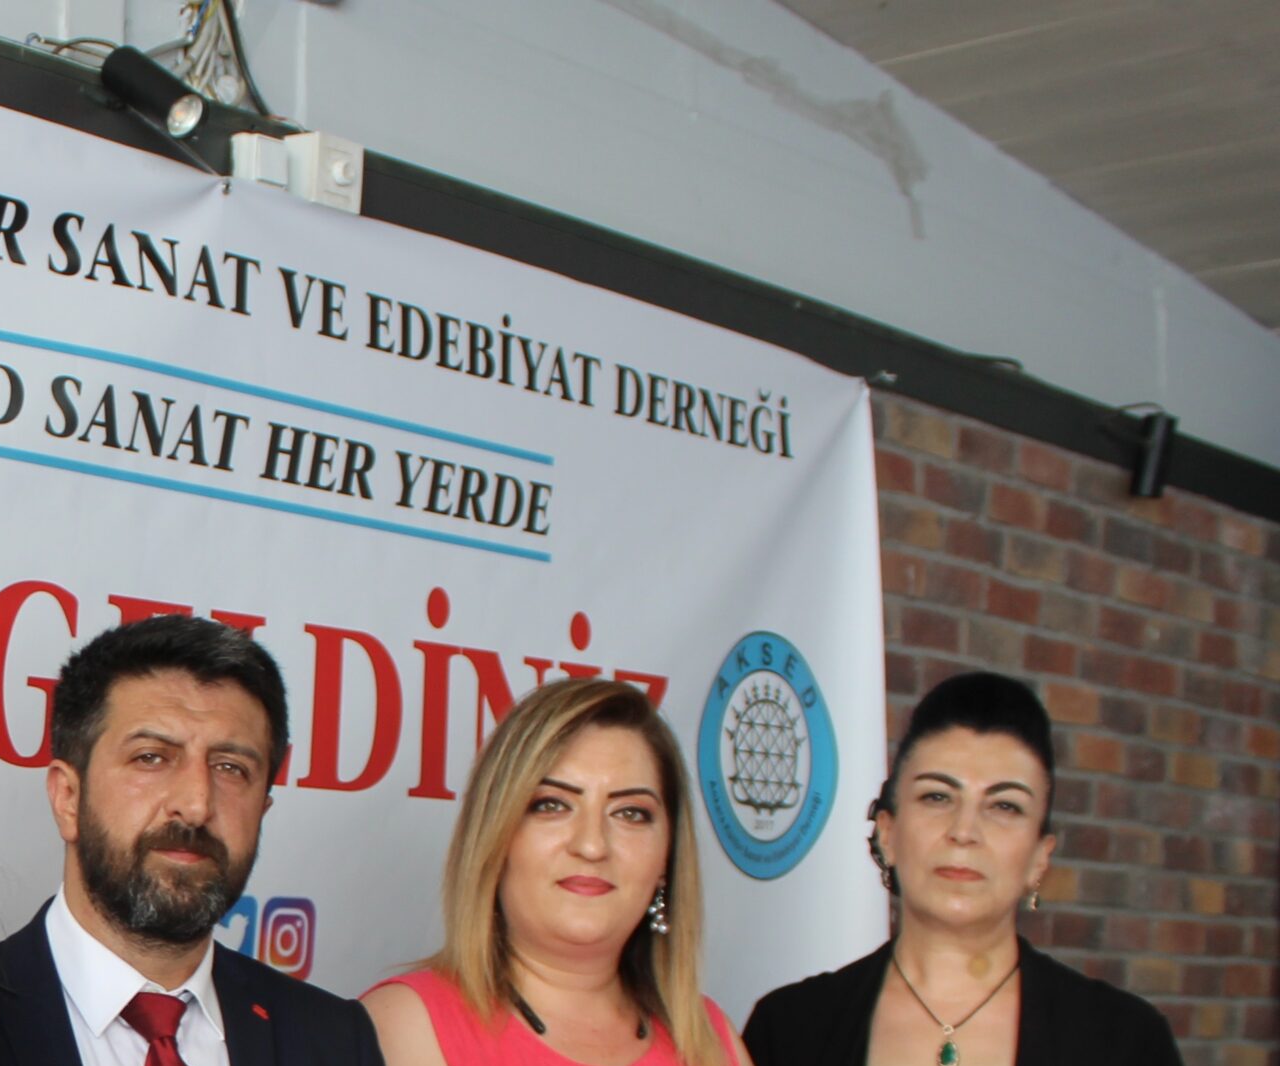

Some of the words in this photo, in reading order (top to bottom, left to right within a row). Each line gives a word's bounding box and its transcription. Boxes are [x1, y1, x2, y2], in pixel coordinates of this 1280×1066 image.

[47, 212, 260, 316] SANAT
[278, 267, 349, 341] VE
[365, 292, 602, 408] EDEBİYAT
[614, 364, 795, 461] DERNEĞİ
[44, 375, 250, 471] SANAT
[260, 422, 377, 499] HER
[395, 451, 553, 536] YERDE
[717, 642, 817, 709] AKSED
